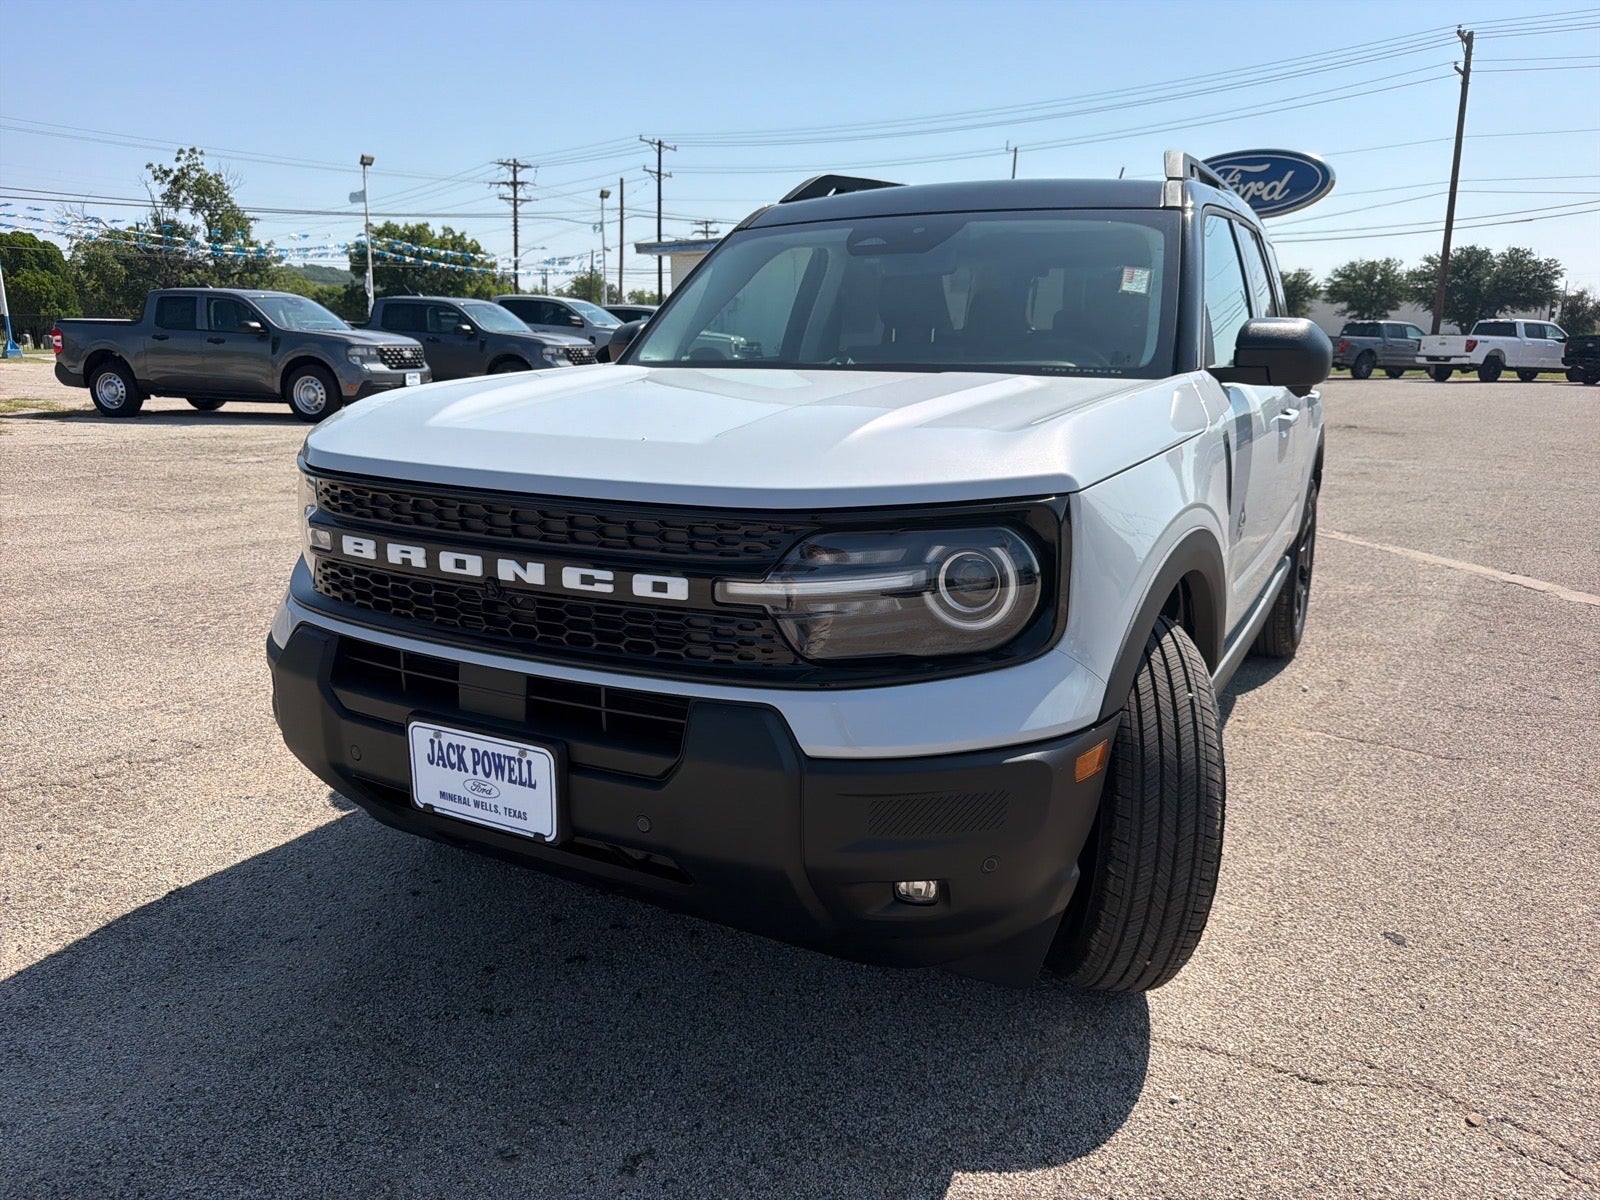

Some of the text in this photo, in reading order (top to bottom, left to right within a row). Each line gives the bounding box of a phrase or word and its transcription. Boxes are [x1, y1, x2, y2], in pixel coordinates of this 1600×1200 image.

[1214, 163, 1295, 203] Ford
[341, 534, 690, 601] BRONCO
[427, 738, 537, 790] JACK POWELL
[439, 790, 528, 821] MINERAL WELLS, TEXAS
[470, 780, 493, 796] Ford
